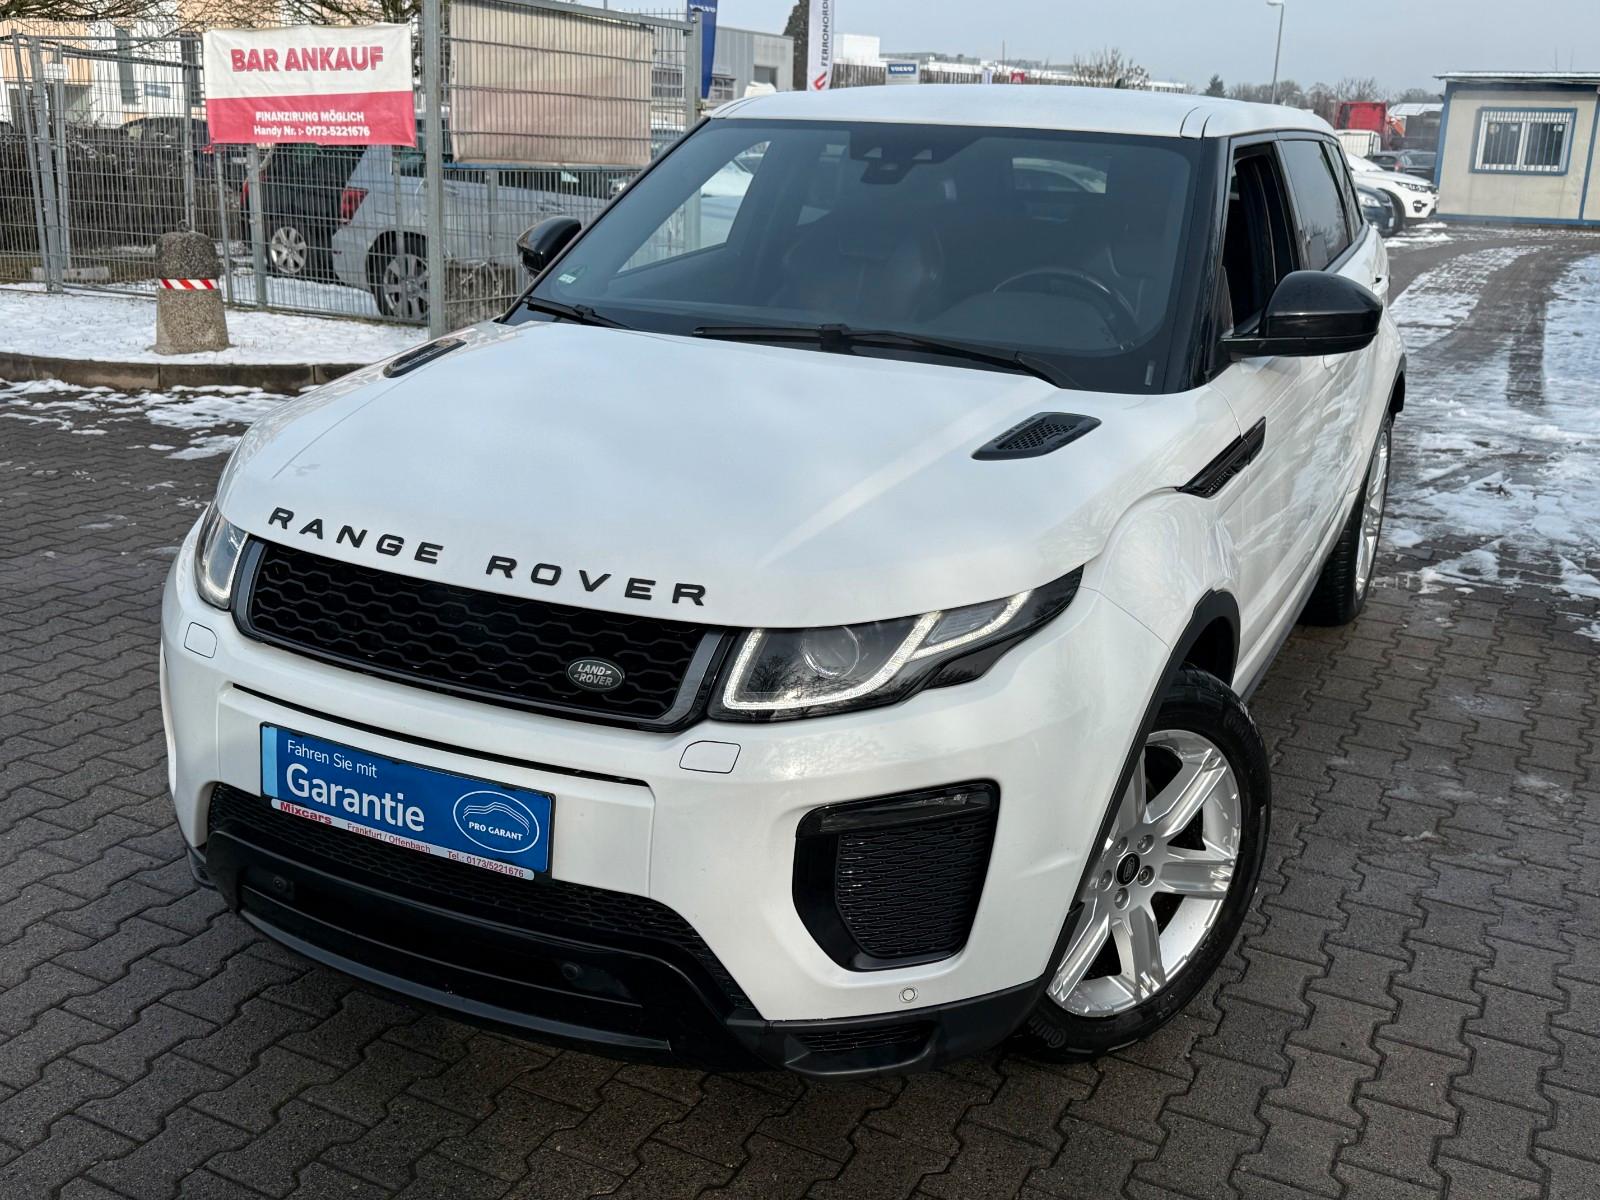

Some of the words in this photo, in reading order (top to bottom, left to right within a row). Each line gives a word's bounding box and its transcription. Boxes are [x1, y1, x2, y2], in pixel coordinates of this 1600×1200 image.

[231, 48, 279, 72] BAR
[284, 46, 384, 72] ANKAUF
[255, 111, 319, 122] FINANZIRUNG
[320, 109, 365, 122] MÖGLICH
[254, 125, 282, 137] Handy
[268, 506, 444, 564] RANGE
[485, 555, 706, 607] ROVER
[578, 663, 606, 675] LAND
[578, 674, 613, 686] ROVER
[287, 739, 330, 765] Fahren
[333, 752, 353, 771] Sie
[356, 762, 378, 779] mit
[286, 762, 425, 832] Garantie
[280, 801, 333, 826] Mixcars
[347, 822, 384, 840] Frankfurt
[388, 834, 431, 854] Offenbach
[466, 855, 525, 878] 0173/5221676
[468, 821, 486, 833] PRO
[488, 825, 523, 841] GARANT
